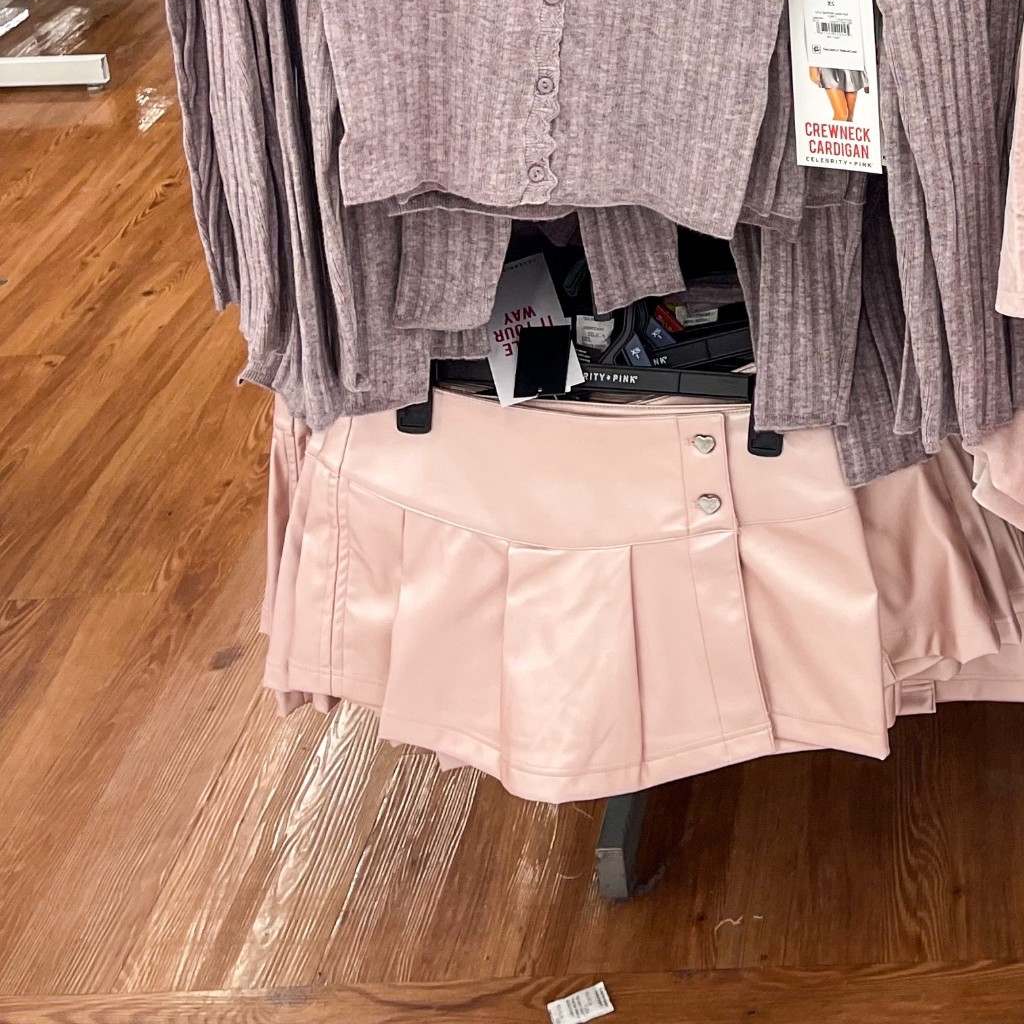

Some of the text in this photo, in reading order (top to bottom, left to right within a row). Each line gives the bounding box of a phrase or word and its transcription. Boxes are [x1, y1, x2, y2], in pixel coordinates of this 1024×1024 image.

[805, 122, 871, 142] CREWNECK
[809, 139, 869, 159] CARDIGAN
[805, 156, 848, 165] CELEBRITY
[504, 306, 537, 325] WAY
